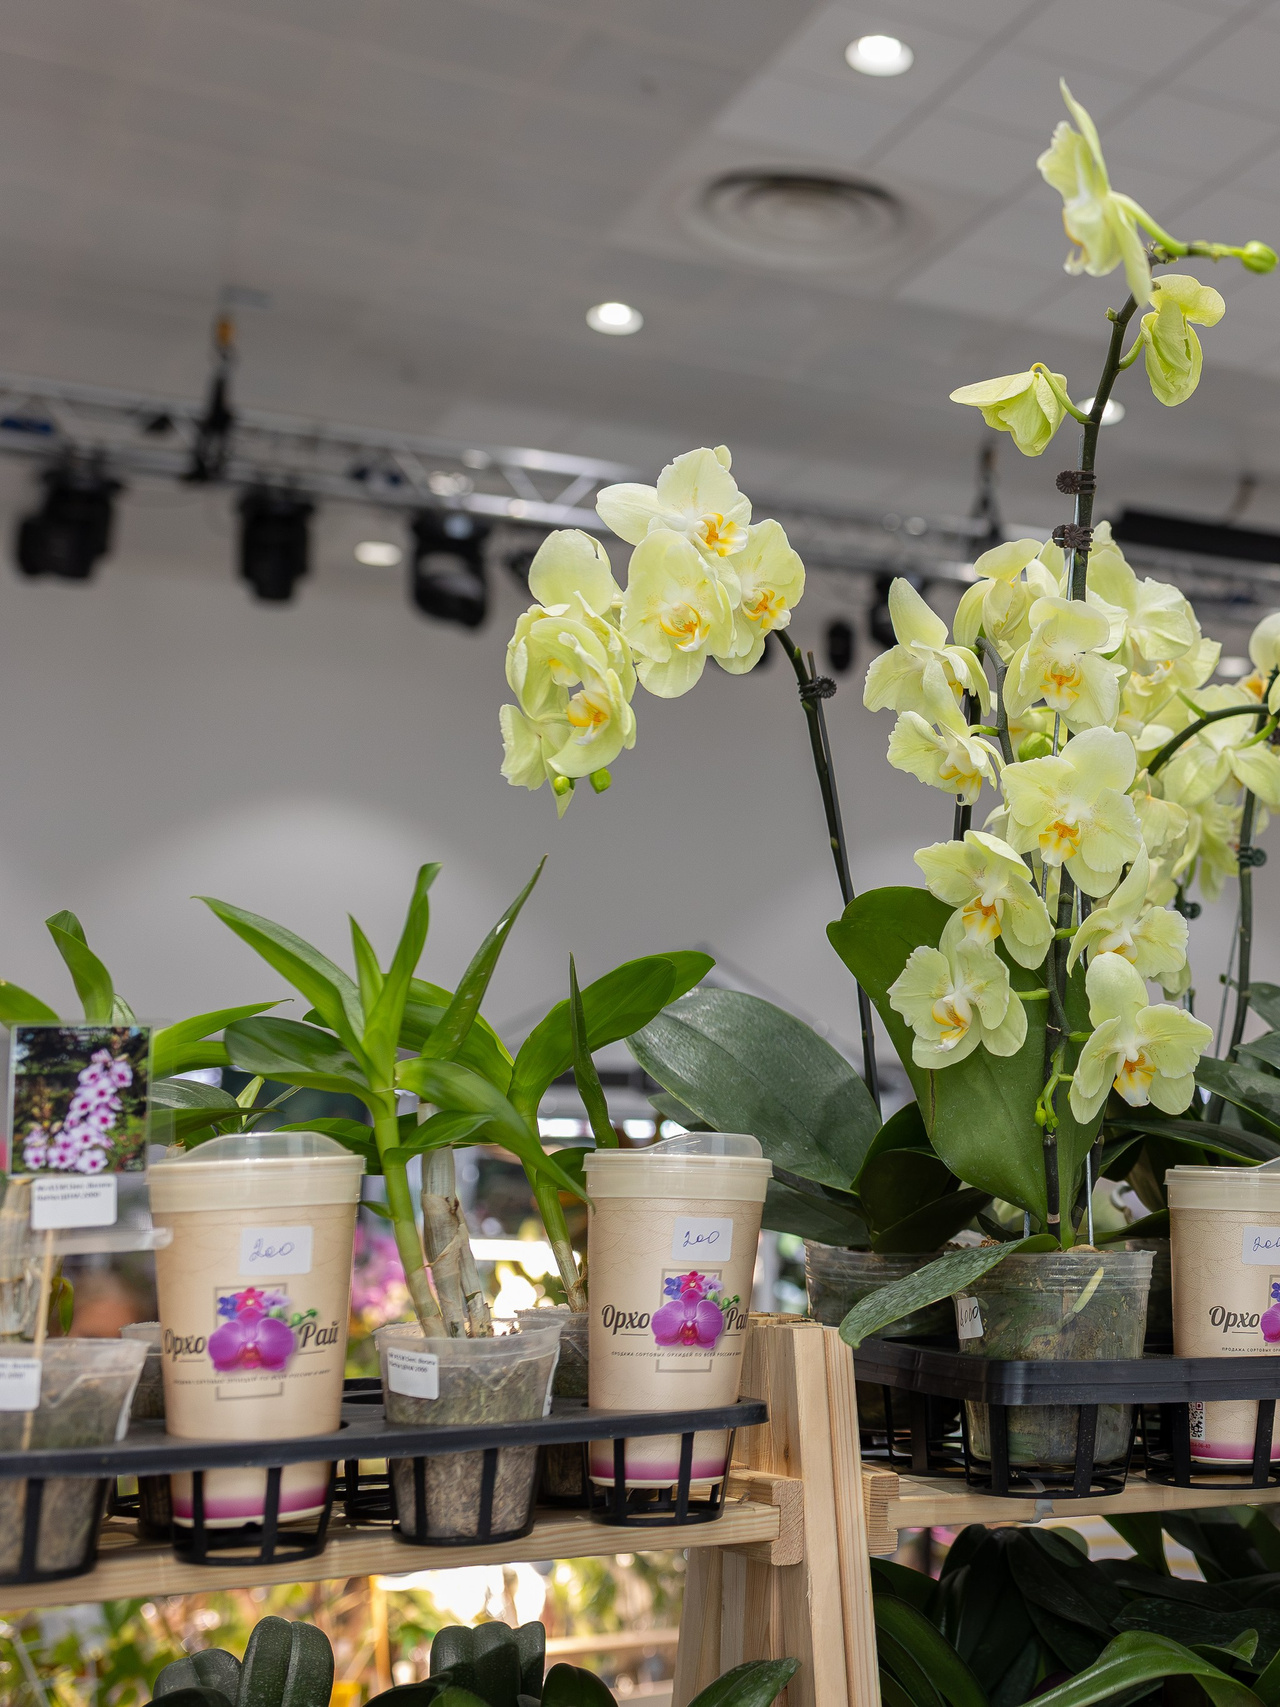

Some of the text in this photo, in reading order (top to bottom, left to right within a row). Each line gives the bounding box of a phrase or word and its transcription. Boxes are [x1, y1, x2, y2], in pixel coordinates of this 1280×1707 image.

[601, 1304, 651, 1335] Орхо
[1208, 1305, 1261, 1334] Орхо
[164, 1320, 340, 1361] Орхо Рай
